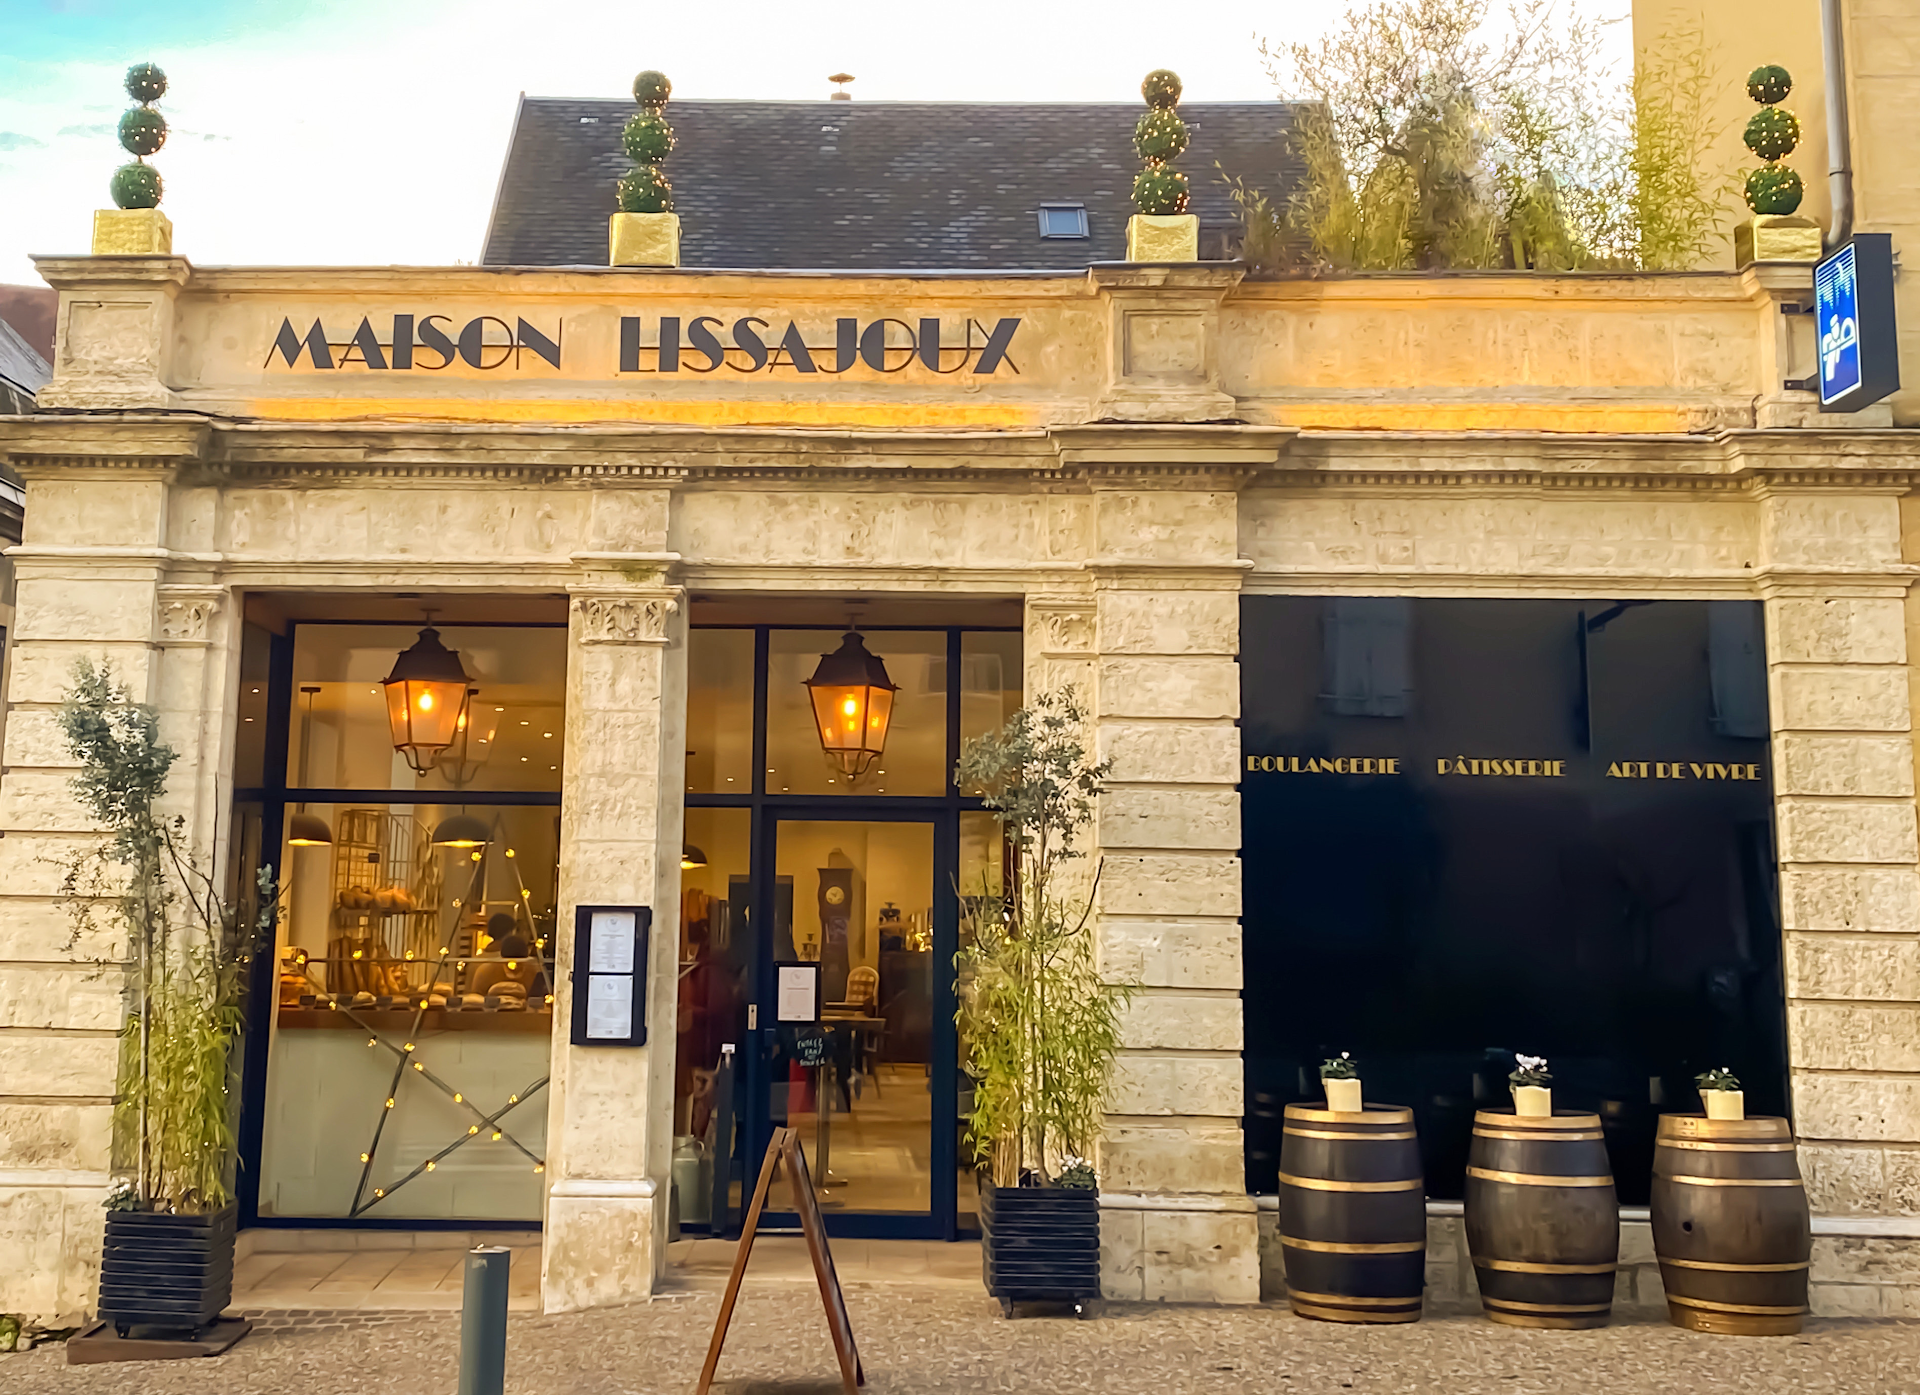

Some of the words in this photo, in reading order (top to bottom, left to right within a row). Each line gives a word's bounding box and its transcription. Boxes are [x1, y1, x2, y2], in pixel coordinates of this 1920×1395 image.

[264, 314, 562, 371] MAISON
[615, 316, 1021, 375] LISSAJOUX
[1247, 755, 1401, 774] BOULANGERIE
[1437, 754, 1567, 777] PÂTISSERIE
[1605, 760, 1651, 778] ART
[1655, 761, 1686, 779] DE
[1689, 762, 1762, 780] VIVRE
